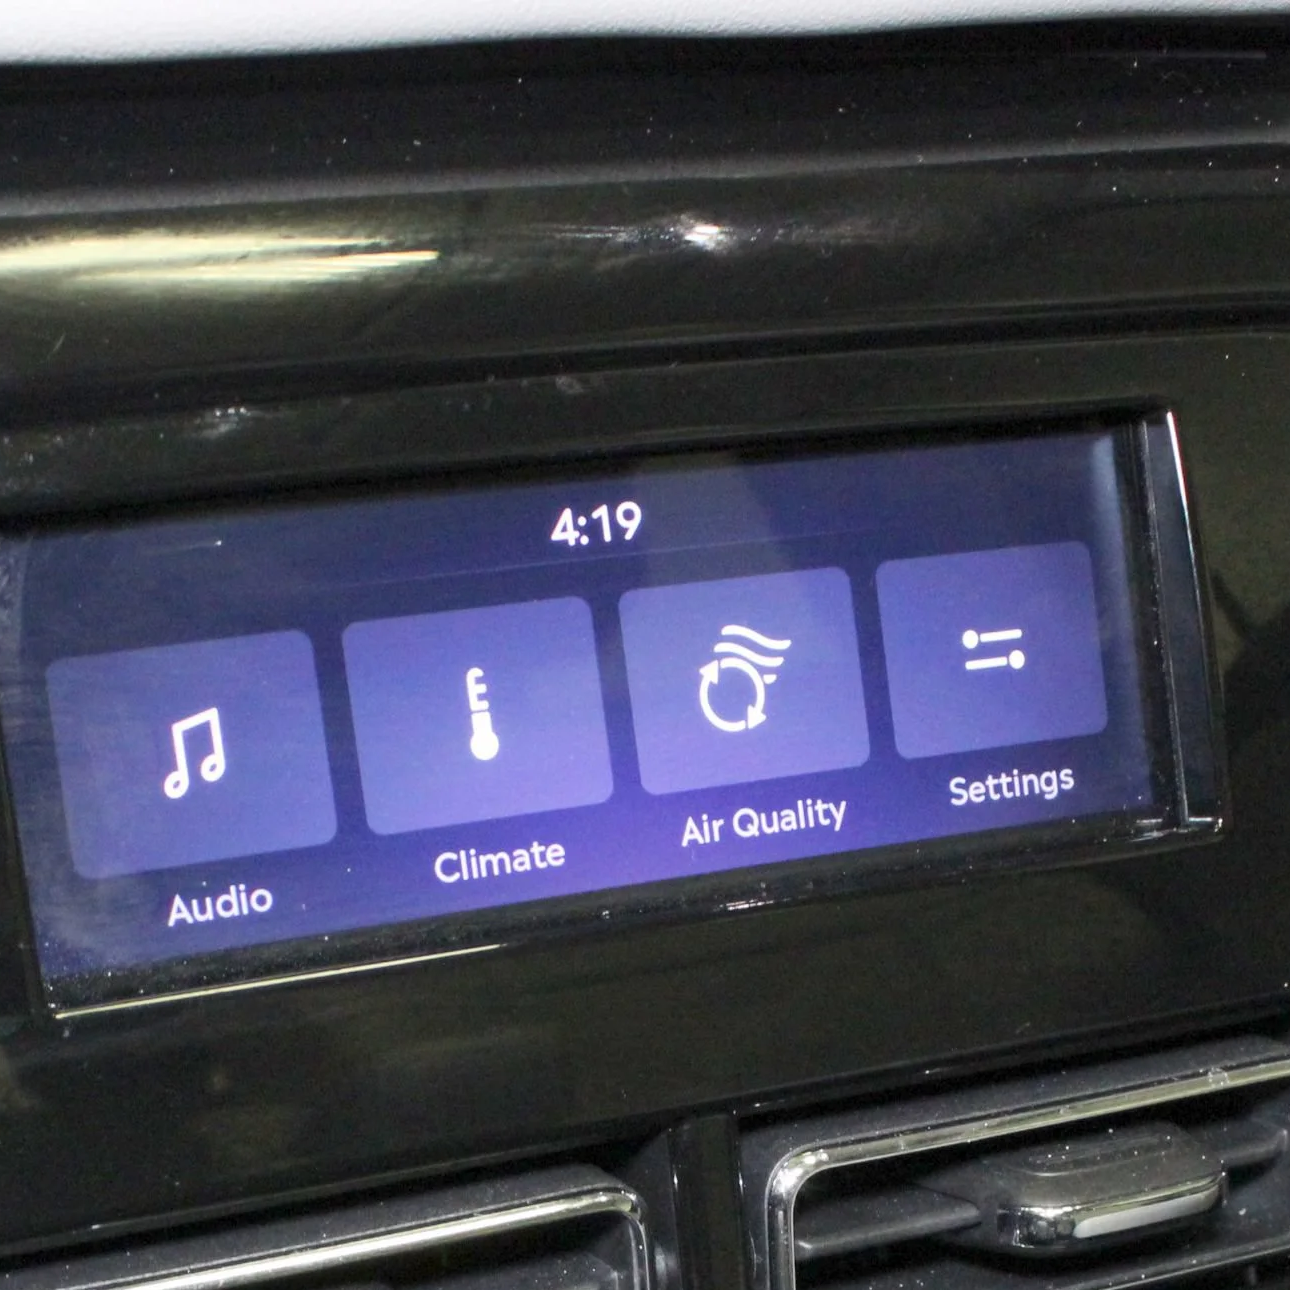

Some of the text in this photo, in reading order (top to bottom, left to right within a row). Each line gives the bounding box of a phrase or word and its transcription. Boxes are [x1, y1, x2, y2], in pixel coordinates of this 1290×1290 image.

[549, 500, 644, 548] 4:19
[948, 767, 1076, 808] Settings
[680, 798, 848, 849] Air Quality
[433, 839, 567, 885] Climate
[166, 882, 274, 928] Audio
